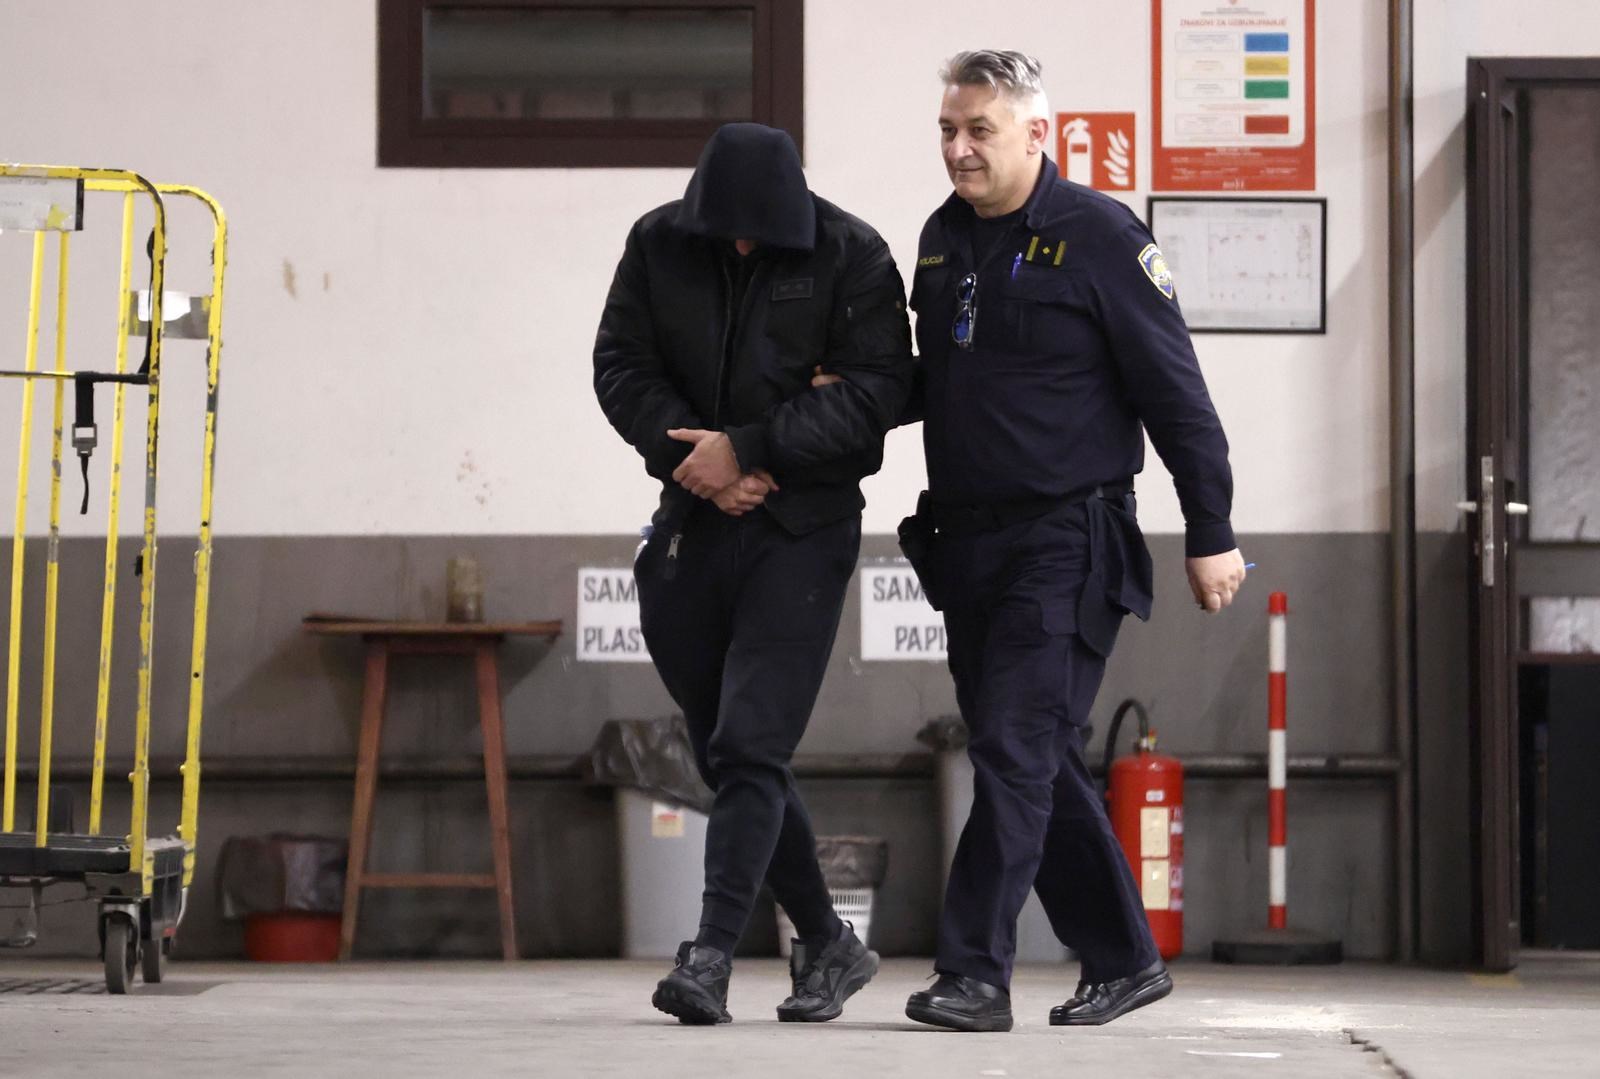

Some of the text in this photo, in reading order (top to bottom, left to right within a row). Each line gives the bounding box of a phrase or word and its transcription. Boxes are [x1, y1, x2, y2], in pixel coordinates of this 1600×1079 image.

[584, 576, 637, 603] SAM
[873, 576, 926, 602] SAM
[584, 626, 647, 653] PLAS
[895, 625, 945, 652] PAPI
